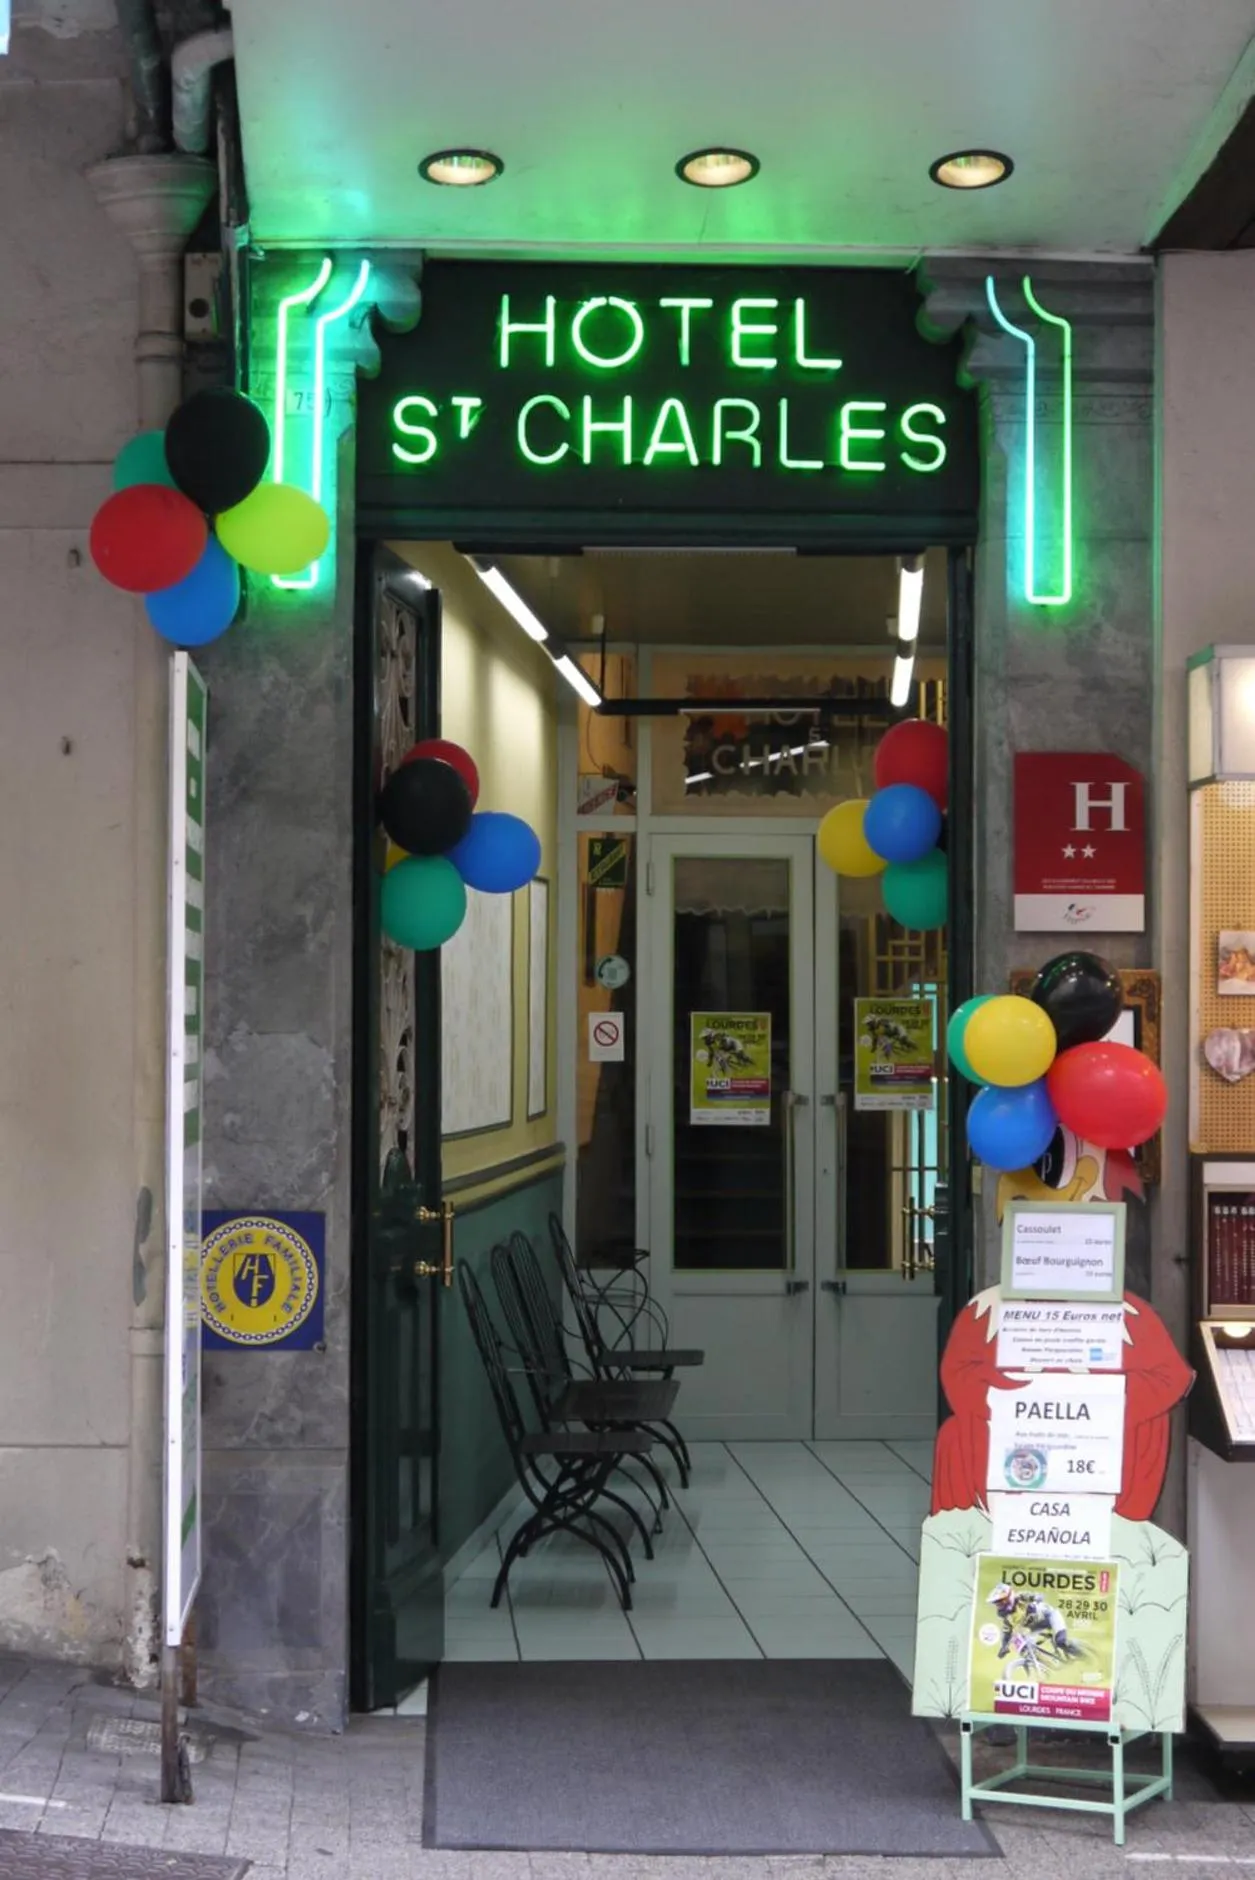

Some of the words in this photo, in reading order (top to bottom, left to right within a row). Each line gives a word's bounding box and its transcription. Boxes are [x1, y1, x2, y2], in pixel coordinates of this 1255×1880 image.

[500, 294, 843, 369] HOTEL
[517, 395, 947, 472] CHARLES
[1069, 781, 1131, 832] H
[1017, 1224, 1062, 1234] Cassoulet
[1043, 1257, 1104, 1269] Bourguignon
[1003, 1309, 1041, 1320] MENU
[1046, 1310, 1060, 1320] 15
[1063, 1310, 1097, 1321] Euros
[1101, 1312, 1122, 1321] net
[1015, 1401, 1091, 1421] PAELLA
[1067, 1459, 1096, 1474] 18€
[1030, 1502, 1071, 1517] CASA
[1007, 1526, 1091, 1545] ESPAÑOLA
[1002, 1570, 1096, 1591] LOURDES
[1058, 1599, 1073, 1610] 28
[1076, 1600, 1091, 1611] 29
[1093, 1601, 1108, 1612] 30
[1066, 1610, 1098, 1621] AVRIL
[1002, 1684, 1035, 1699] UCI
[1019, 1704, 1051, 1714] LOURDES
[1055, 1707, 1082, 1717] FRANCE
